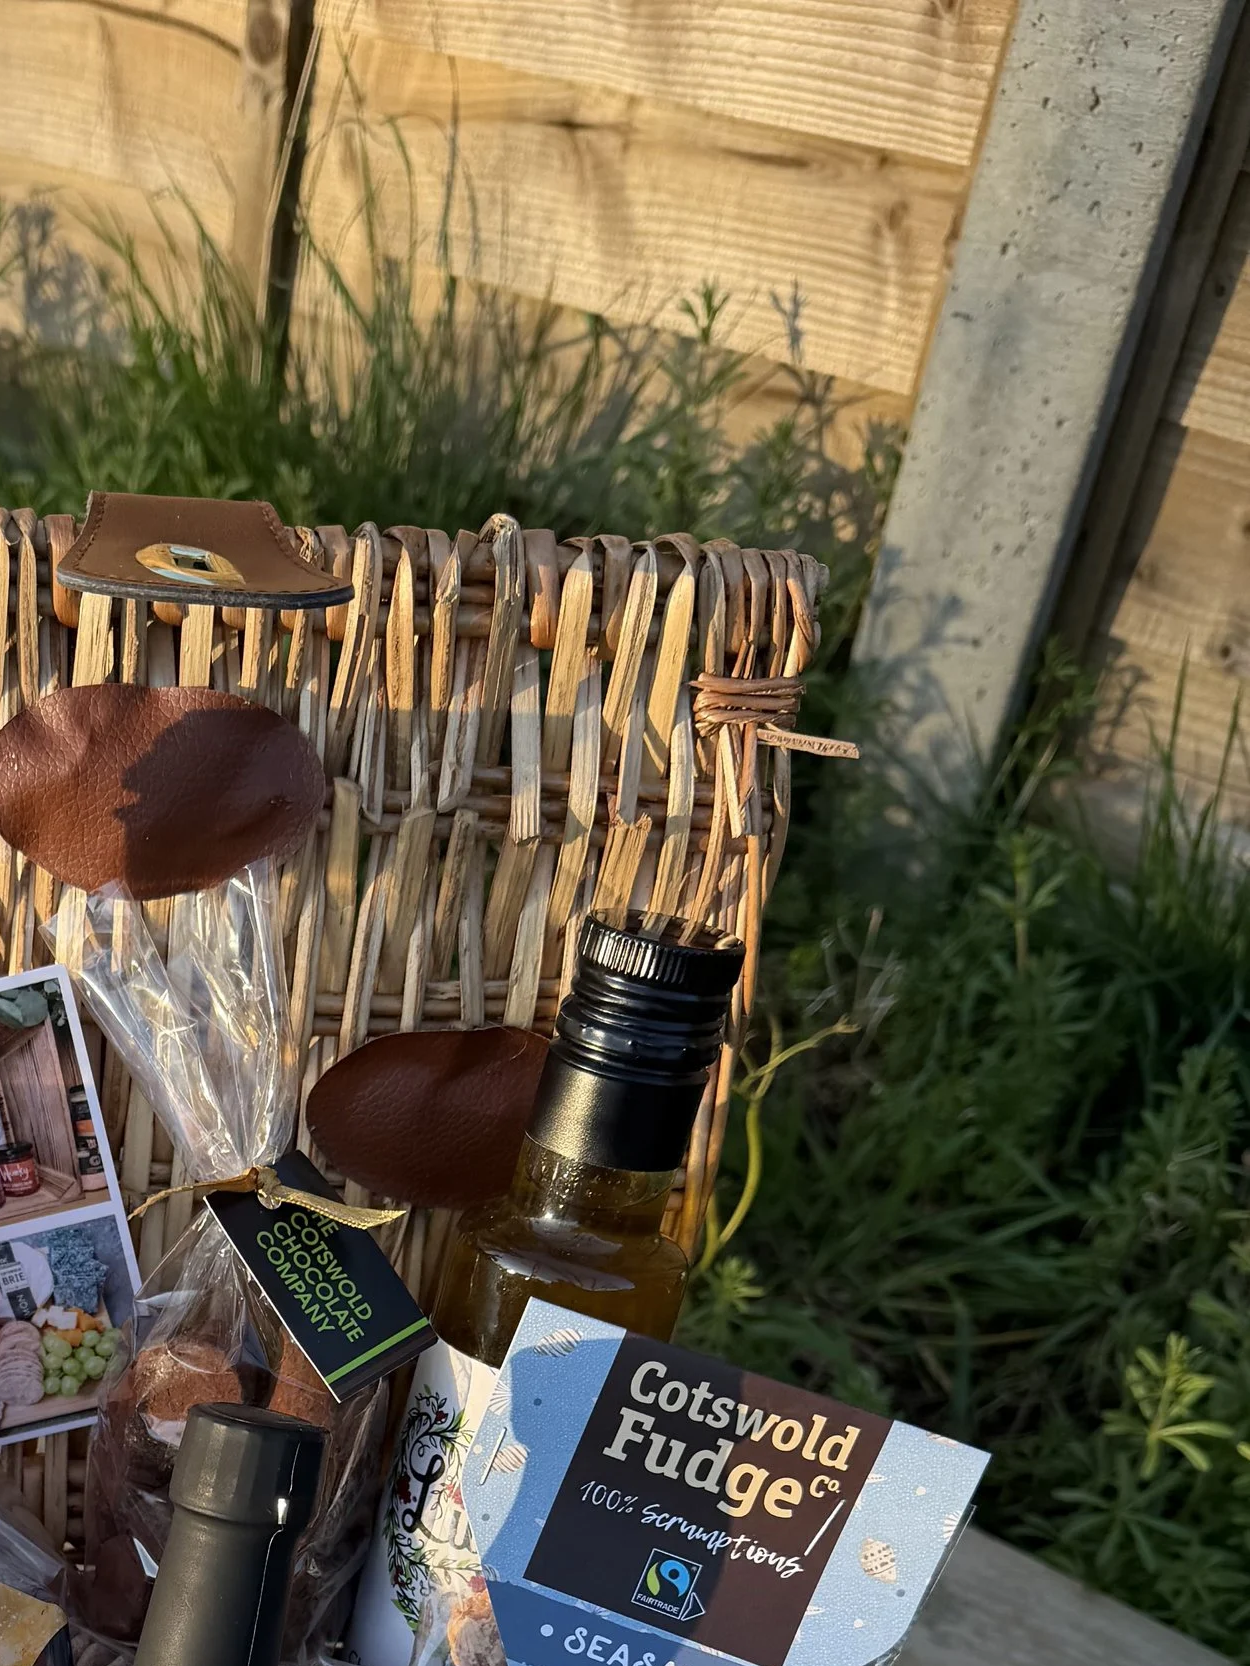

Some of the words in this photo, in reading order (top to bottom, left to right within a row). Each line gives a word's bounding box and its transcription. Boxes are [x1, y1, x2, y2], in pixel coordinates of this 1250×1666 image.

[2, 1272, 26, 1286] BRIE
[256, 1231, 335, 1333] COMPANY
[274, 1221, 365, 1343] CHOCOLATE
[291, 1212, 372, 1320] COTSWOLD
[602, 1407, 803, 1519] Fudge
[809, 1475, 841, 1498] Co.
[630, 1360, 861, 1471] Cotswold
[580, 1480, 638, 1514] 100%
[636, 1592, 680, 1614] FAIRTRADE
